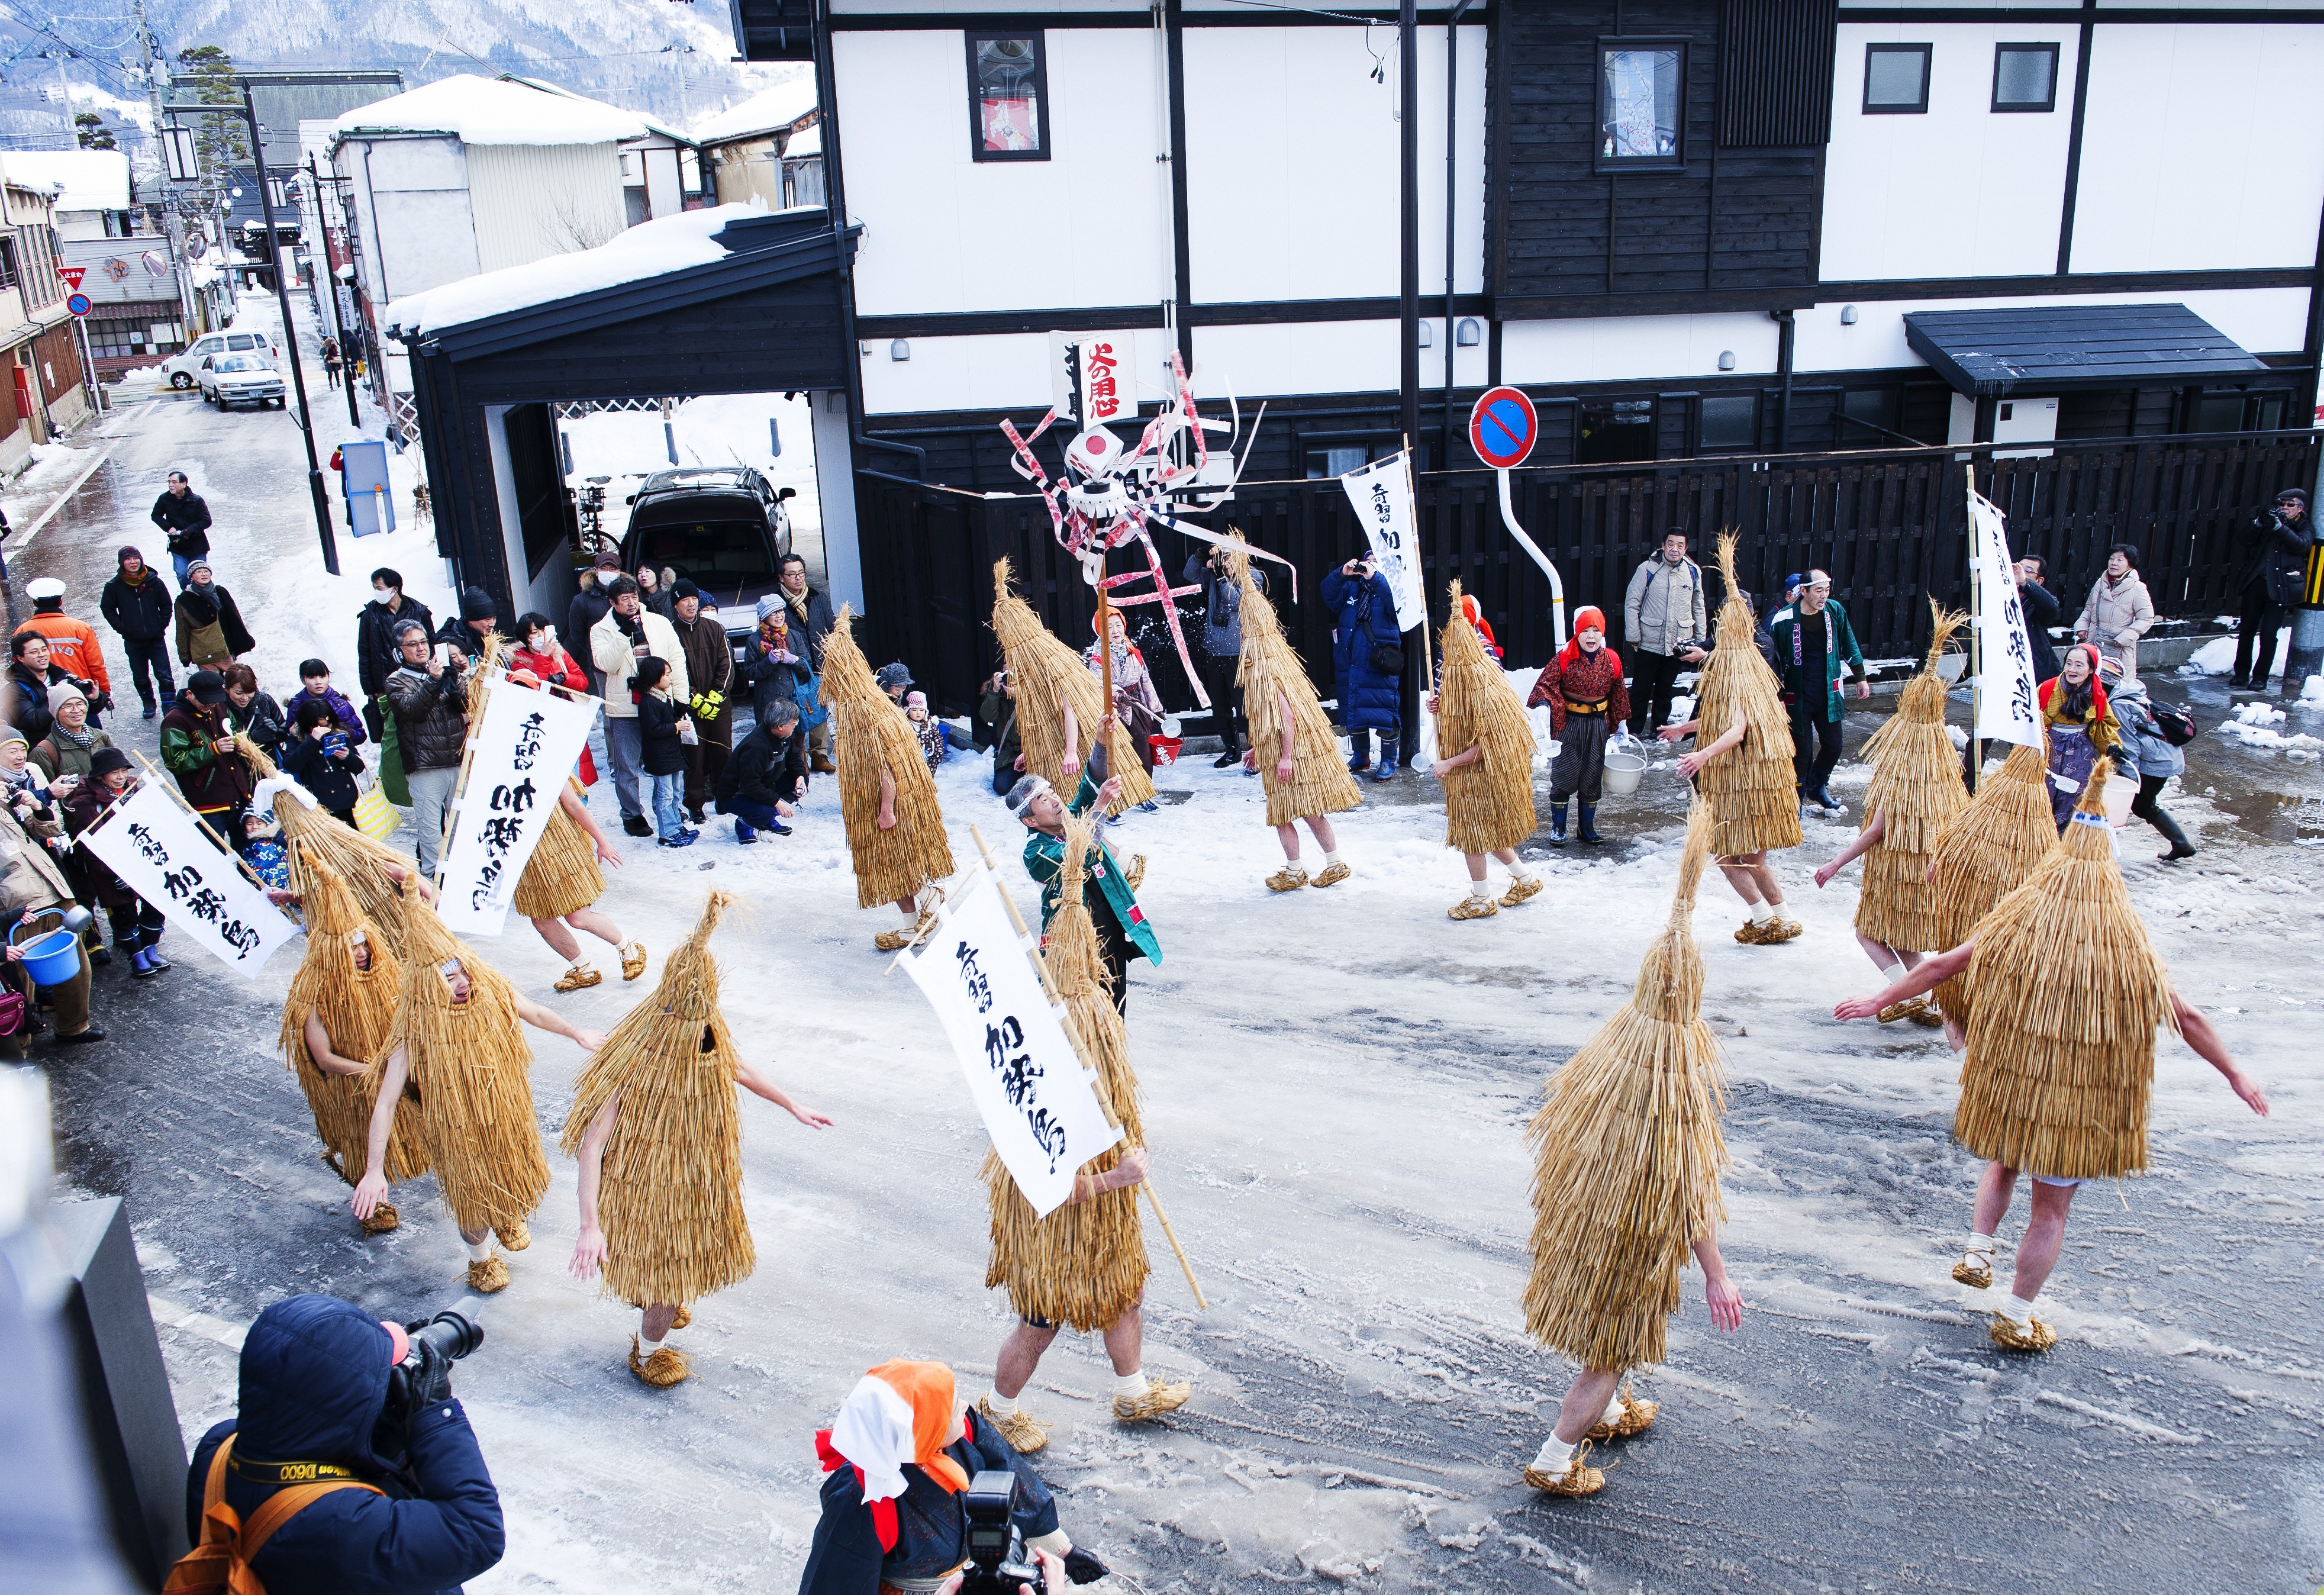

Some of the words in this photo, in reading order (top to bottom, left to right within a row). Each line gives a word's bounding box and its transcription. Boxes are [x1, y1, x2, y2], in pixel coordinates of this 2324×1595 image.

[1087, 343, 1120, 420] 火の用心
[50, 645, 75, 657] IYO
[280, 1463, 317, 1481] D600
